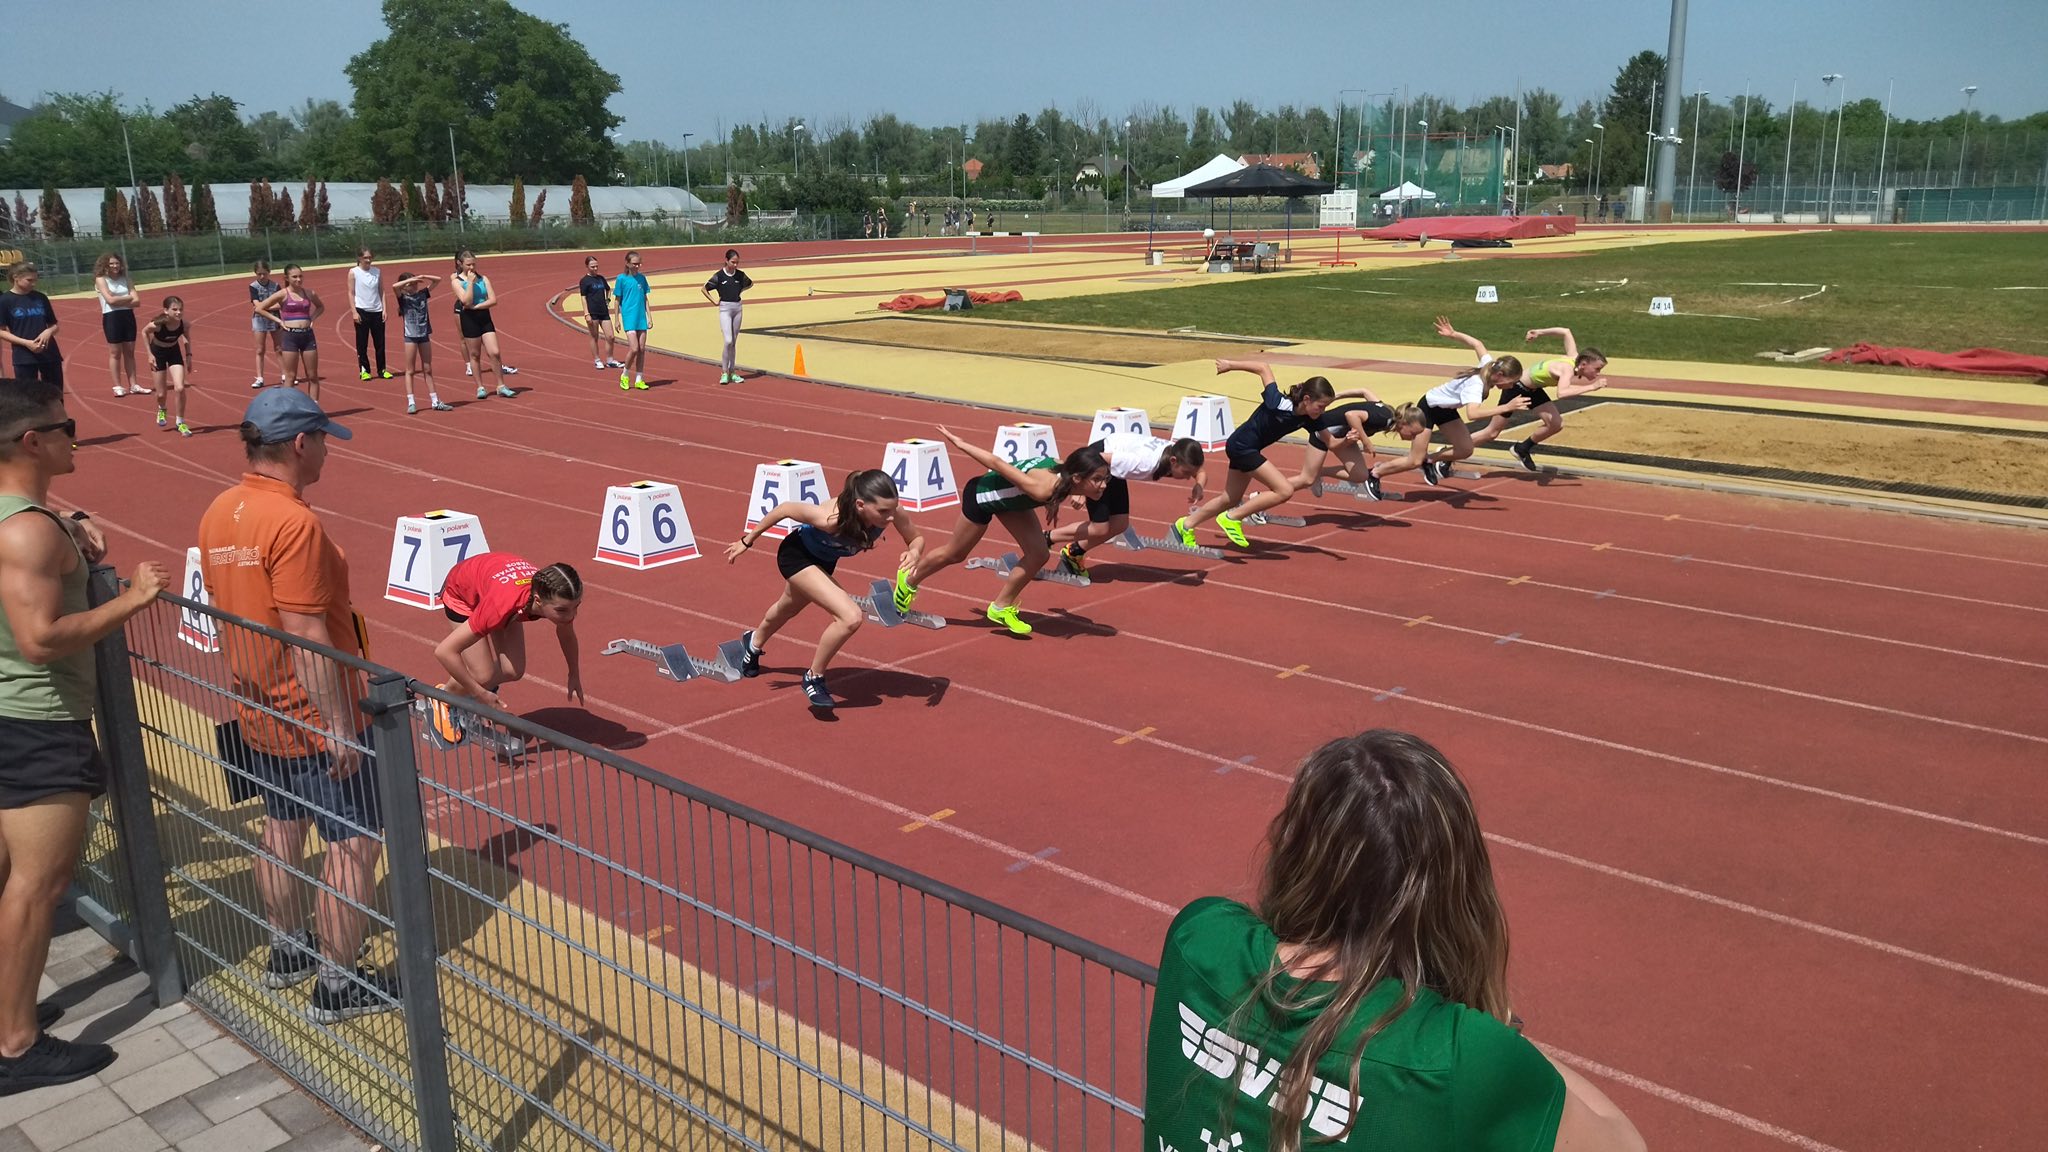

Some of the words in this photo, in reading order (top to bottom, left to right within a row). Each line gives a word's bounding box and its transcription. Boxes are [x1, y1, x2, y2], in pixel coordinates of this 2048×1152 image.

[1478, 290, 1487, 298] 10
[1488, 290, 1495, 298] 10
[1663, 302, 1671, 310] 14
[1186, 408, 1198, 436] 1
[1216, 407, 1225, 436] 1
[1004, 439, 1018, 463] 3
[890, 457, 908, 492] 4
[927, 456, 944, 490] 4
[653, 492, 671, 501] polanik
[761, 479, 779, 517] 5
[447, 523, 469, 533] polanik
[612, 504, 630, 545] 6
[652, 503, 677, 544] 6
[404, 535, 421, 582] 7
[443, 533, 471, 564] 7
[499, 571, 518, 584] AC
[191, 570, 203, 620] 8
